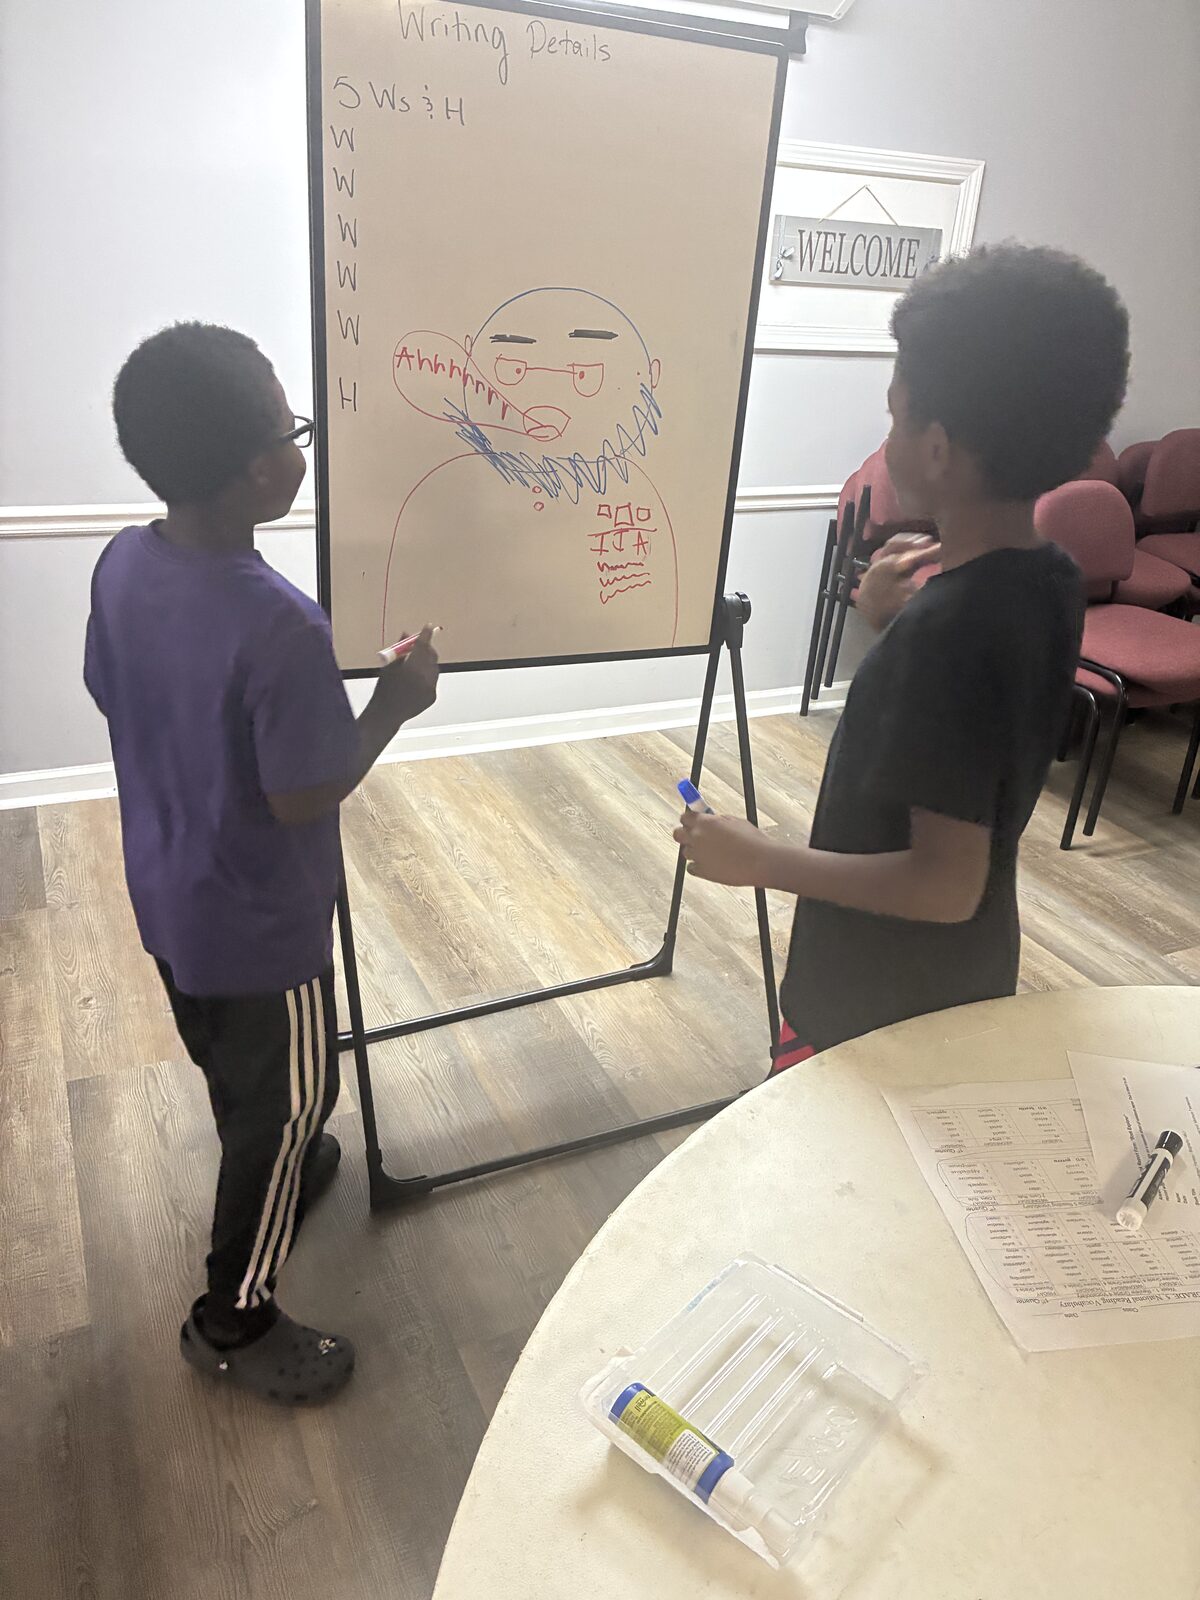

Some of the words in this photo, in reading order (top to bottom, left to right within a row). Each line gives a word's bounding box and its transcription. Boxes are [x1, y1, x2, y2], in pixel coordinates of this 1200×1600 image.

[398, 0, 509, 86] Writing
[525, 20, 612, 62] Details
[333, 76, 361, 109] 5
[369, 81, 411, 113] Ws
[445, 97, 465, 126] H
[330, 125, 355, 152] W
[333, 167, 355, 198] W
[337, 214, 358, 249] W
[798, 229, 920, 279] WELCOME
[337, 261, 357, 292] W
[337, 309, 360, 346] W
[339, 377, 357, 412] H
[1059, 1299, 1102, 1308] Vocabulary
[1100, 1297, 1132, 1305] Reading
[1131, 1294, 1164, 1304] National
